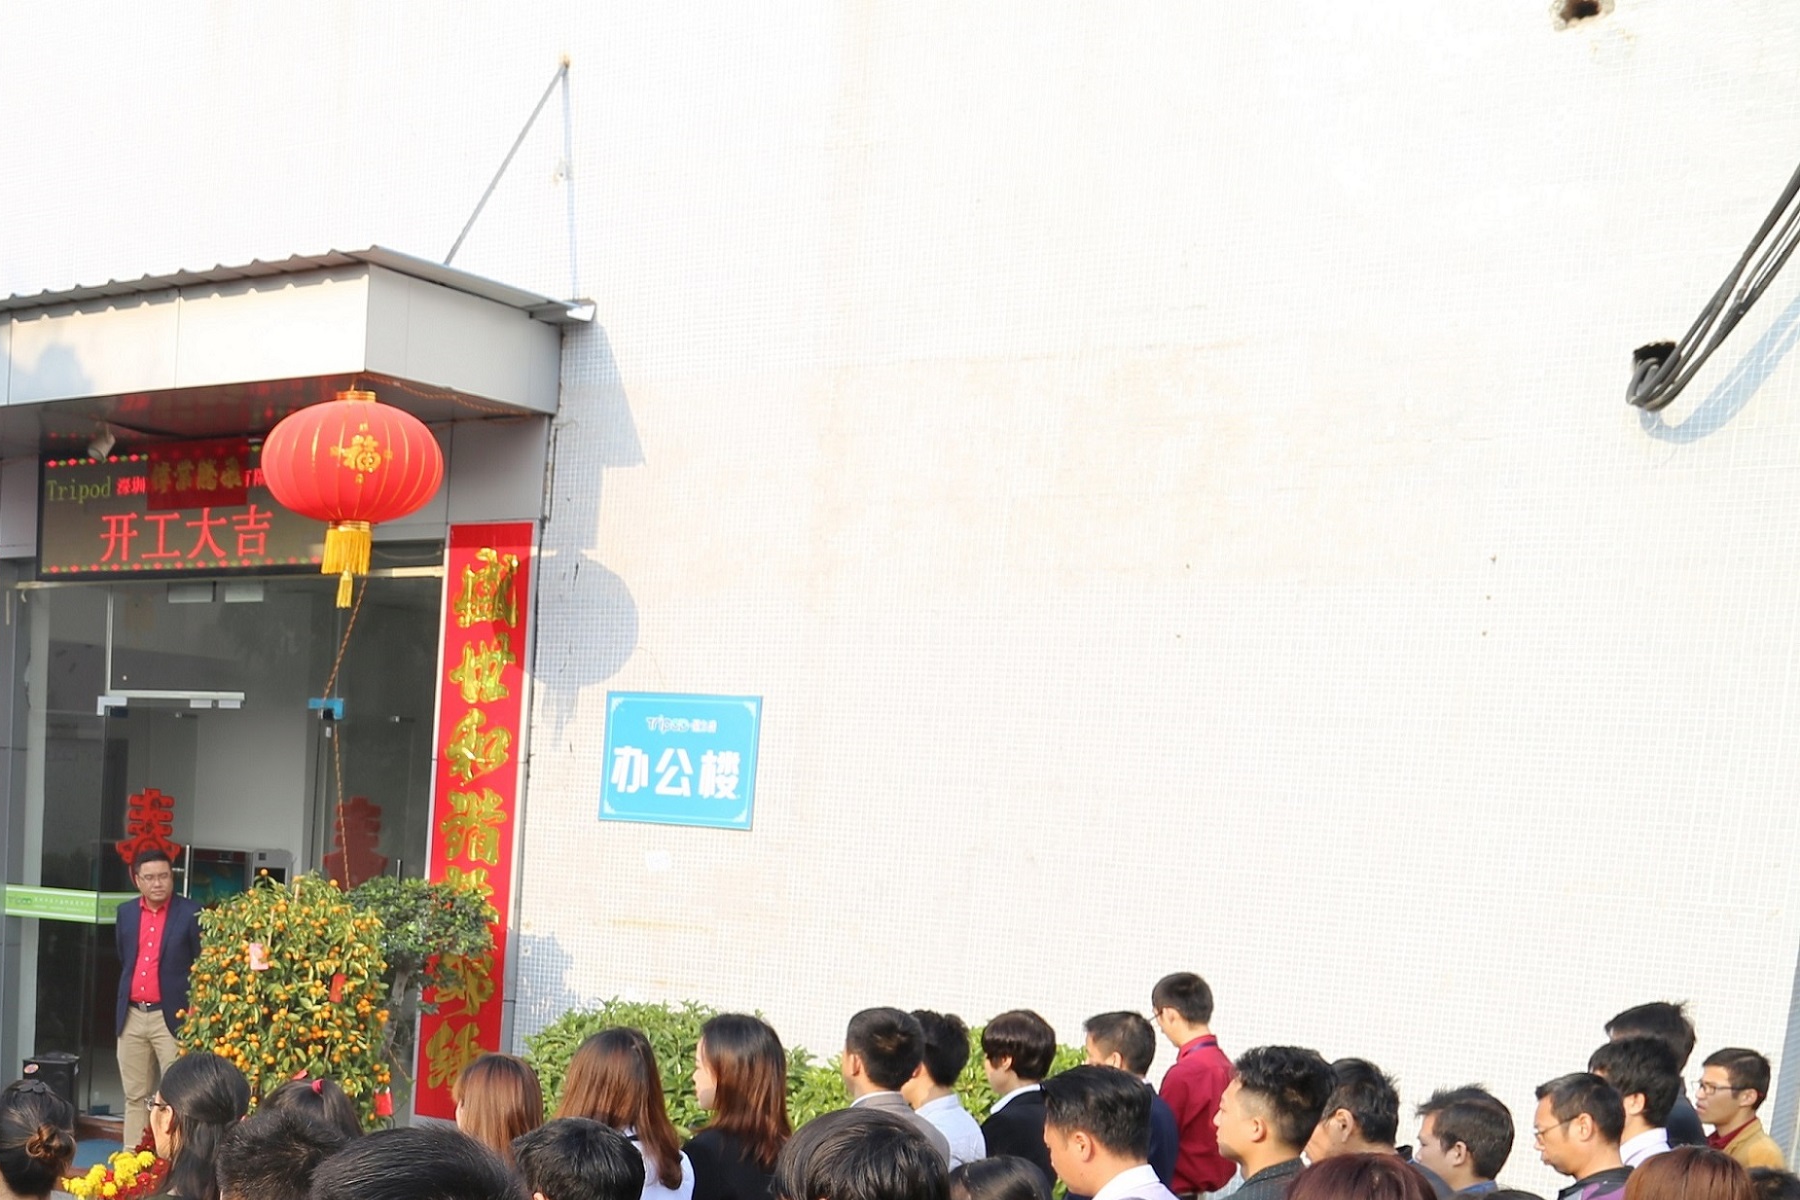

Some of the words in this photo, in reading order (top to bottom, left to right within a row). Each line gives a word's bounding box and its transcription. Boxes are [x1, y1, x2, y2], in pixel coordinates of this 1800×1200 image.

[47, 476, 111, 504] Tripod
[100, 504, 273, 562] 开工大吉
[610, 745, 741, 800] 办公楼
